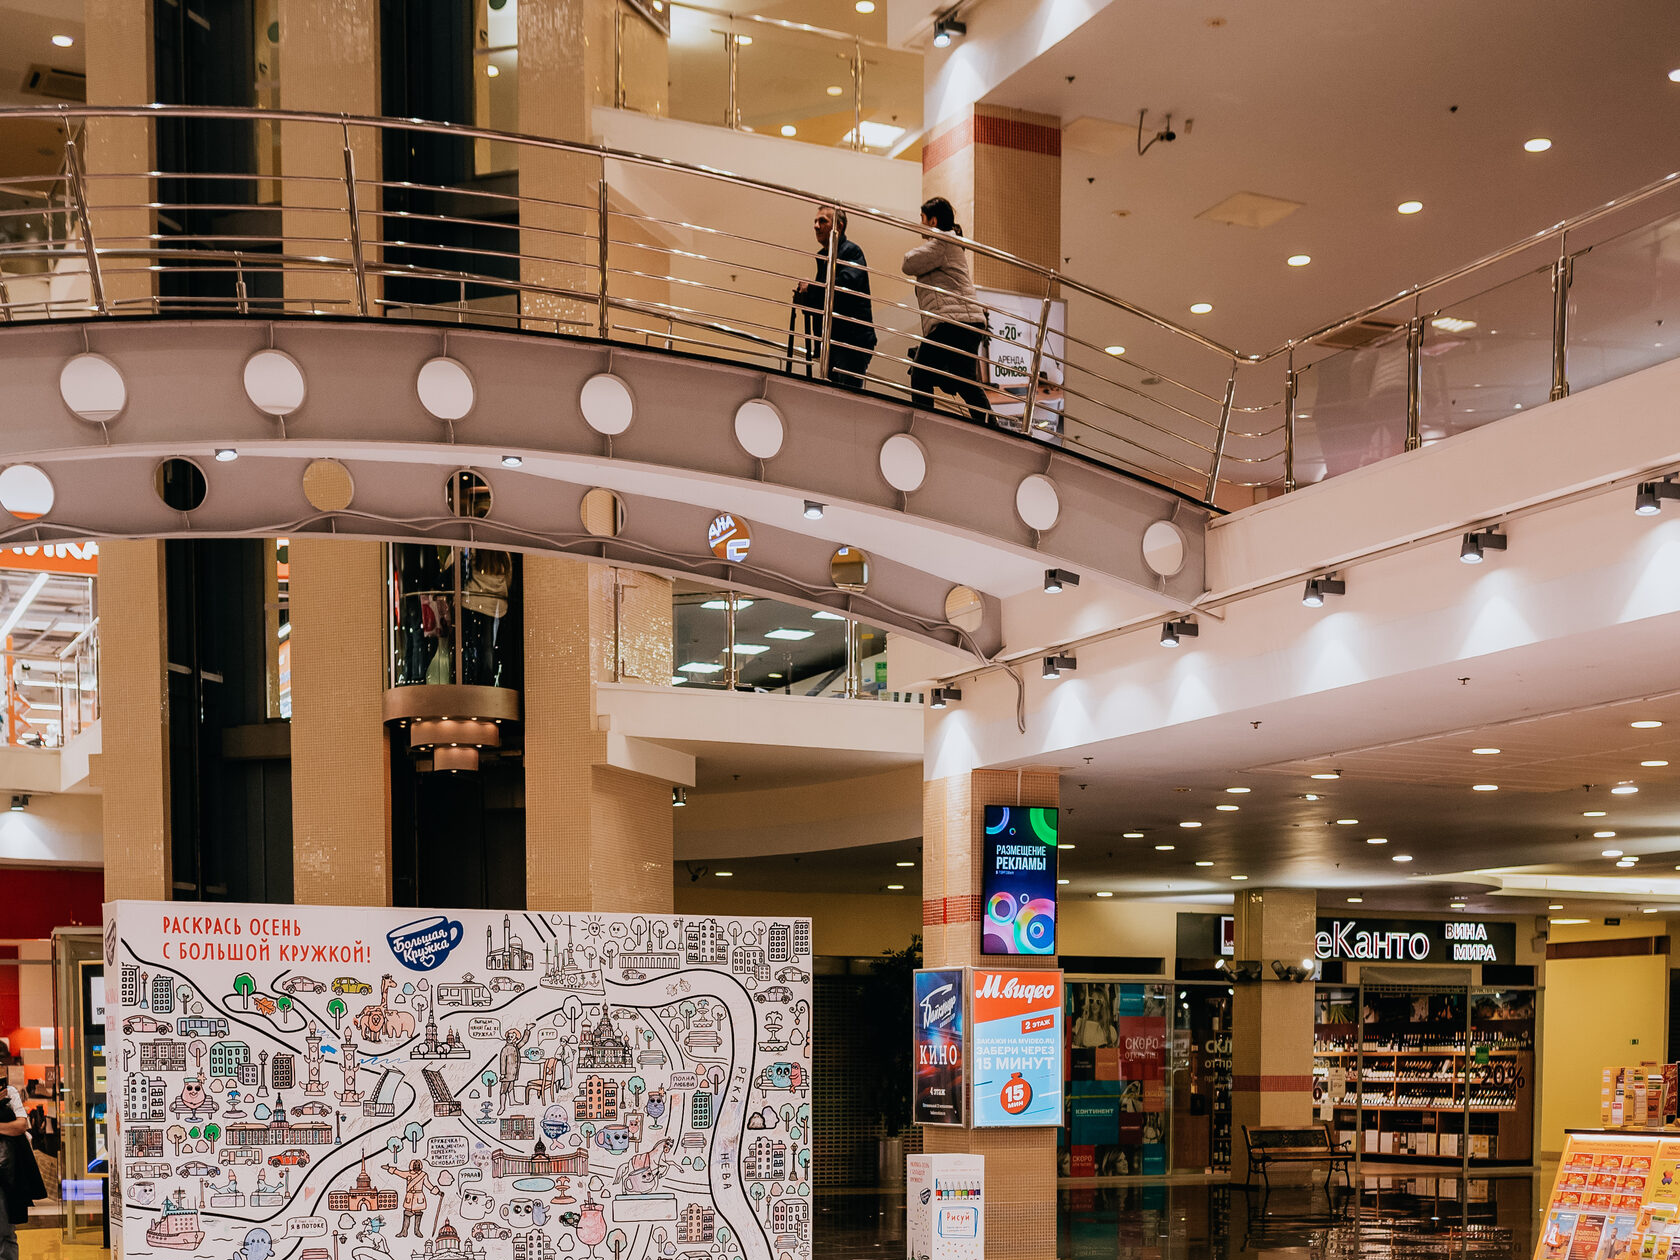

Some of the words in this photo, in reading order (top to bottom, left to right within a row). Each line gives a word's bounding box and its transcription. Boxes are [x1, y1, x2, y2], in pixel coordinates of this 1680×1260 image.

[1005, 326, 1016, 340] 20
[998, 355, 1024, 365] АРЕНДА
[996, 844, 1047, 856] РАЗМЕЩЕНИЕ
[996, 856, 1047, 871] РЕКЛАМЫ
[162, 915, 242, 935] РАСКРАСЬ
[249, 918, 302, 937] ОСЕНЬ
[1444, 922, 1488, 941] ВИНА
[393, 928, 448, 953] Большая
[162, 942, 171, 960] С
[179, 938, 271, 962] БОЛЬШОЙ
[279, 940, 372, 964] КРУЖКОЙ!
[403, 939, 450, 965] Кружка
[1453, 943, 1497, 962] МИРА
[975, 974, 1055, 1004] М.видео
[1025, 1021, 1031, 1030] 2
[975, 1046, 1019, 1055] ЗАБЕРИ
[1021, 1046, 1055, 1055] ЧЕРЕЗ
[1125, 1037, 1159, 1050] СКОРО
[919, 1044, 958, 1066] КИНО
[976, 1057, 992, 1070] 15
[995, 1057, 1055, 1070] МИНУТ
[730, 1066, 747, 1104] РЕКА
[1005, 1084, 1025, 1102] 15
[1007, 1101, 1024, 1109] МИН
[720, 1152, 732, 1190] НЕВА
[946, 1212, 970, 1225] Рисуй
